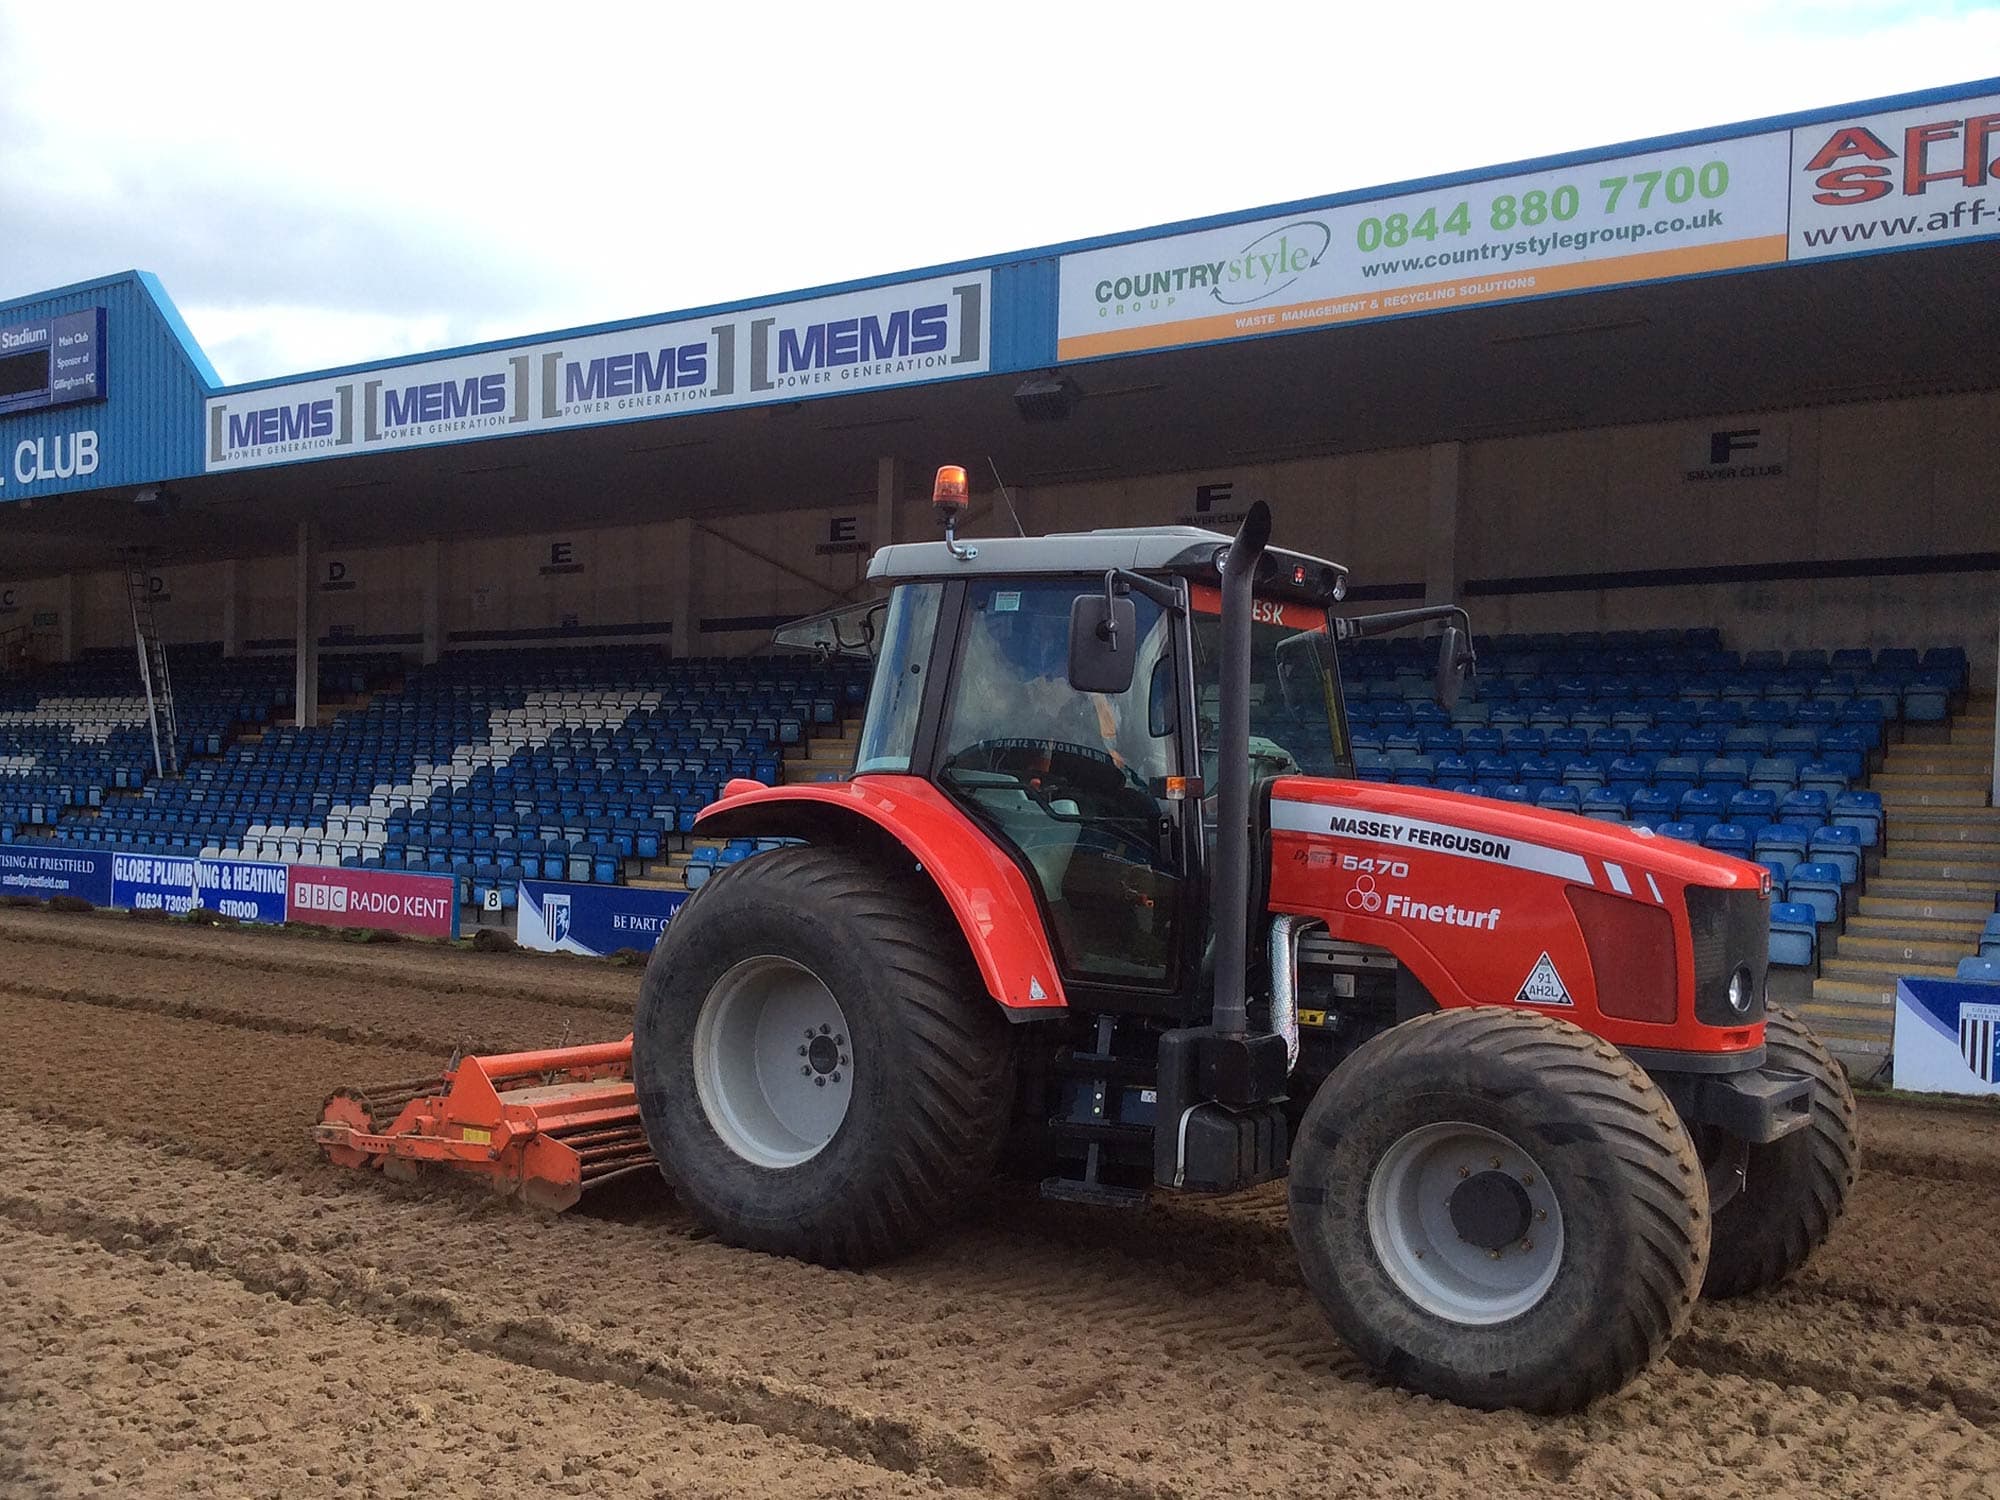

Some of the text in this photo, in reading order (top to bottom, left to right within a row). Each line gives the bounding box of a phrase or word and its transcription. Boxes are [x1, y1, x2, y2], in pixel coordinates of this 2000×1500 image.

[1357, 160, 1729, 252] 0844 880 7700
[1803, 198, 2000, 247] www.aff-
[1362, 209, 1723, 278] www.countrystylegroup.co.uk
[1099, 296, 1176, 317] GROUP
[1235, 276, 1536, 329] WASTE MANAGEMENT & RECYCLING SOLUTIONS
[2, 328, 47, 349] Stadium
[58, 331, 89, 347] Main Club
[778, 303, 948, 374] MEMS
[57, 352, 90, 370] Sponsor of
[565, 342, 707, 403] MEMS
[777, 354, 948, 388] POWER GENERATION
[54, 372, 96, 390] Gillingham FC
[384, 373, 505, 427] MEMS
[565, 388, 709, 417] POWER GENERATION
[228, 399, 333, 449] MEMS
[384, 415, 506, 440] POWER GENERATION
[15, 430, 99, 485] CLUB
[228, 438, 334, 461] POWER GENERATION
[1710, 428, 1760, 465] F
[1739, 464, 1783, 479] CLUB
[1196, 483, 1233, 512] F
[830, 516, 857, 541] E
[552, 542, 573, 564] E
[329, 561, 346, 581] D
[1330, 816, 1510, 860] MASSEY FERGUSON
[27, 856, 38, 869] AT
[40, 857, 95, 874] PRIESTFIELD
[114, 857, 286, 895] GLOBE PLUMBING & HEATING
[1342, 855, 1409, 878] 5470
[135, 892, 162, 909] 01634
[219, 899, 258, 919] STROOD
[297, 885, 448, 919] BBC RADIO KENT
[488, 892, 498, 907] 8
[1385, 894, 1501, 930] Fineturf
[613, 914, 627, 929] BE
[630, 915, 657, 931] PART
[1537, 972, 1552, 984] 91
